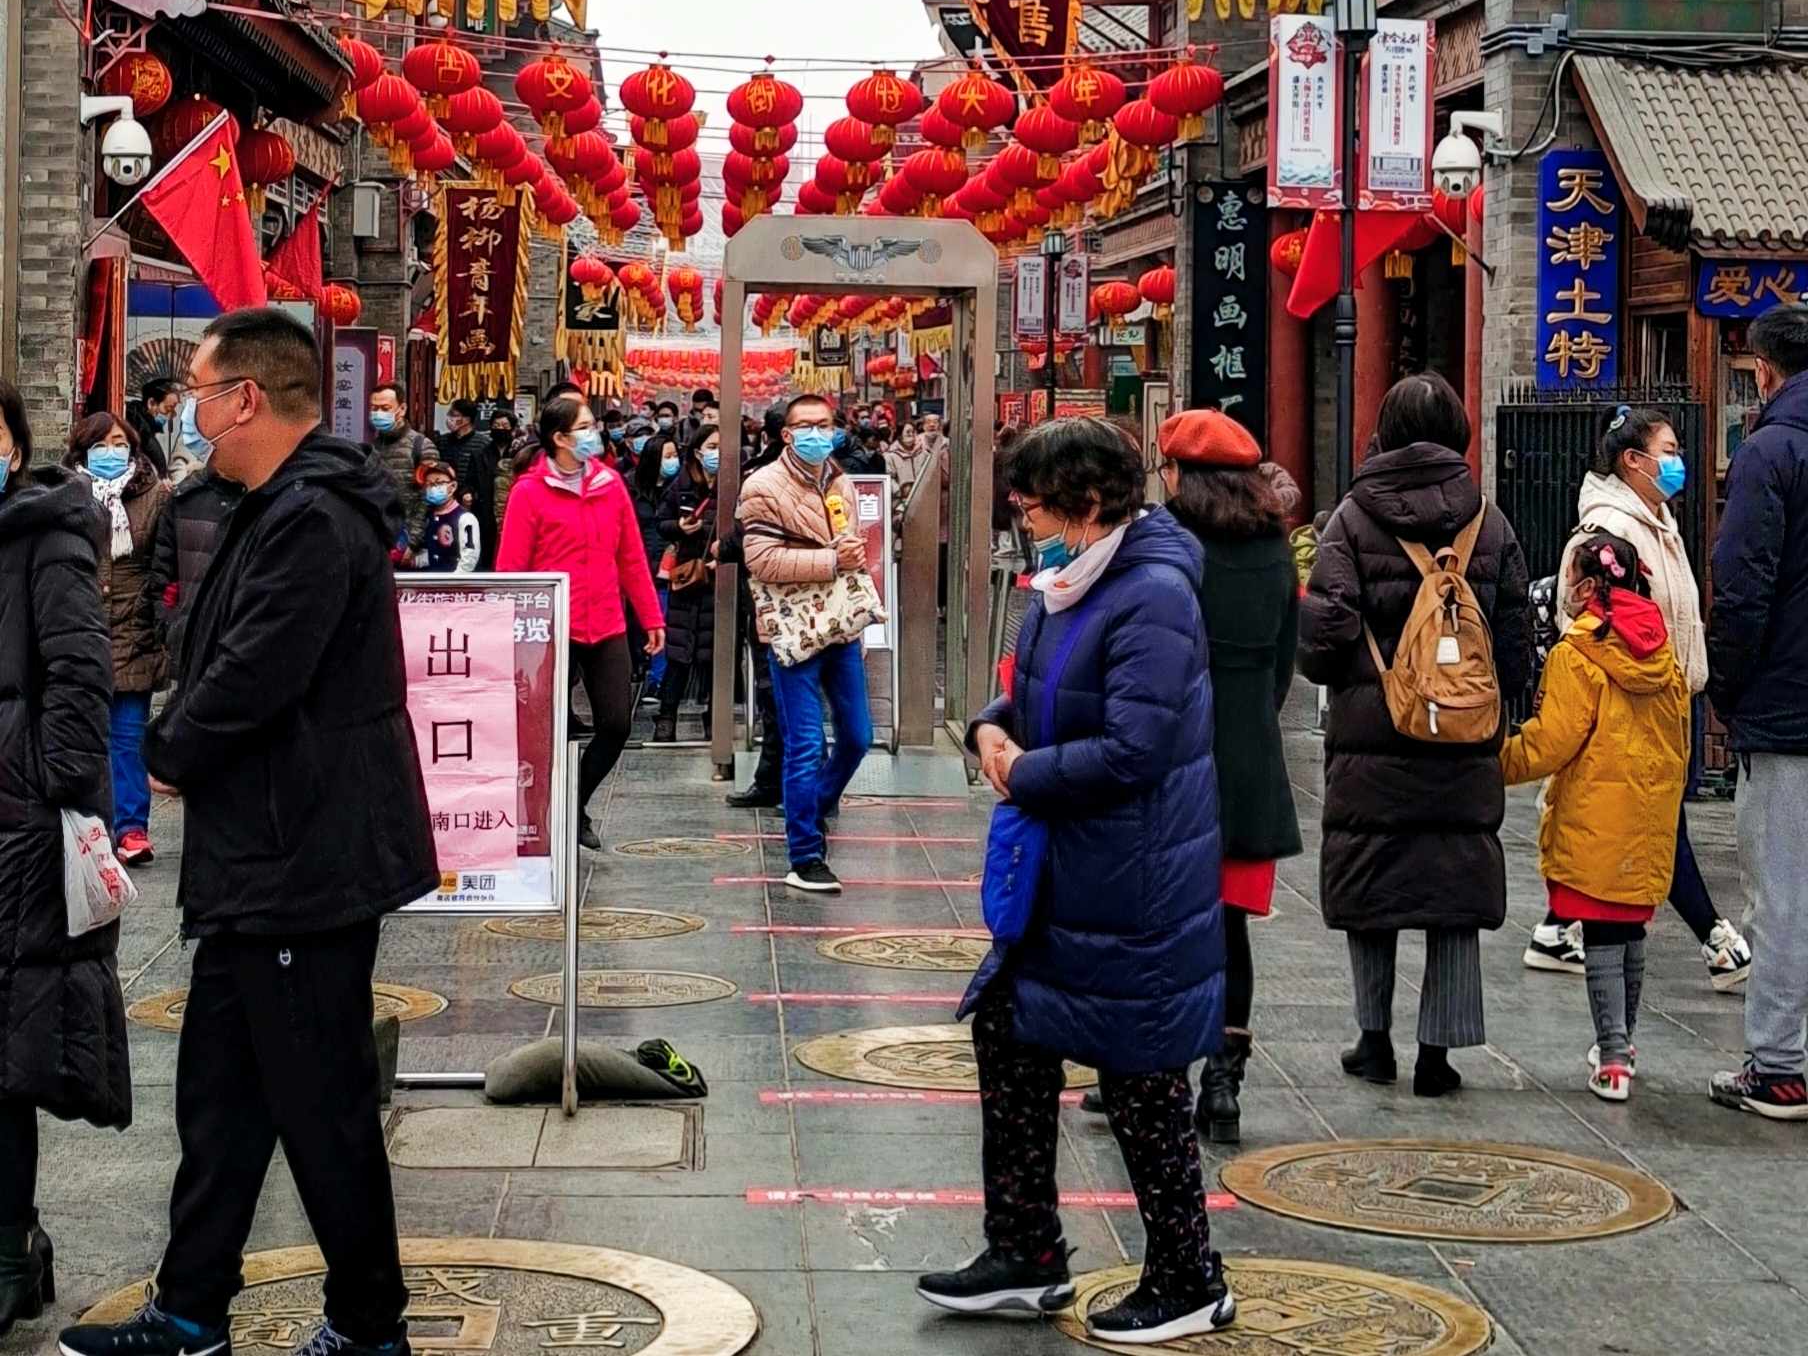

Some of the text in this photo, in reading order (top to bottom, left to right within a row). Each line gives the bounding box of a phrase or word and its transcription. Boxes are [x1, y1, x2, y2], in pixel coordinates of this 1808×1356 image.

[1545, 168, 1615, 379] 天津土特
[464, 525, 475, 549] 1
[427, 627, 473, 765] 出口
[431, 810, 515, 832] 南口进入
[461, 874, 497, 891] 美团
